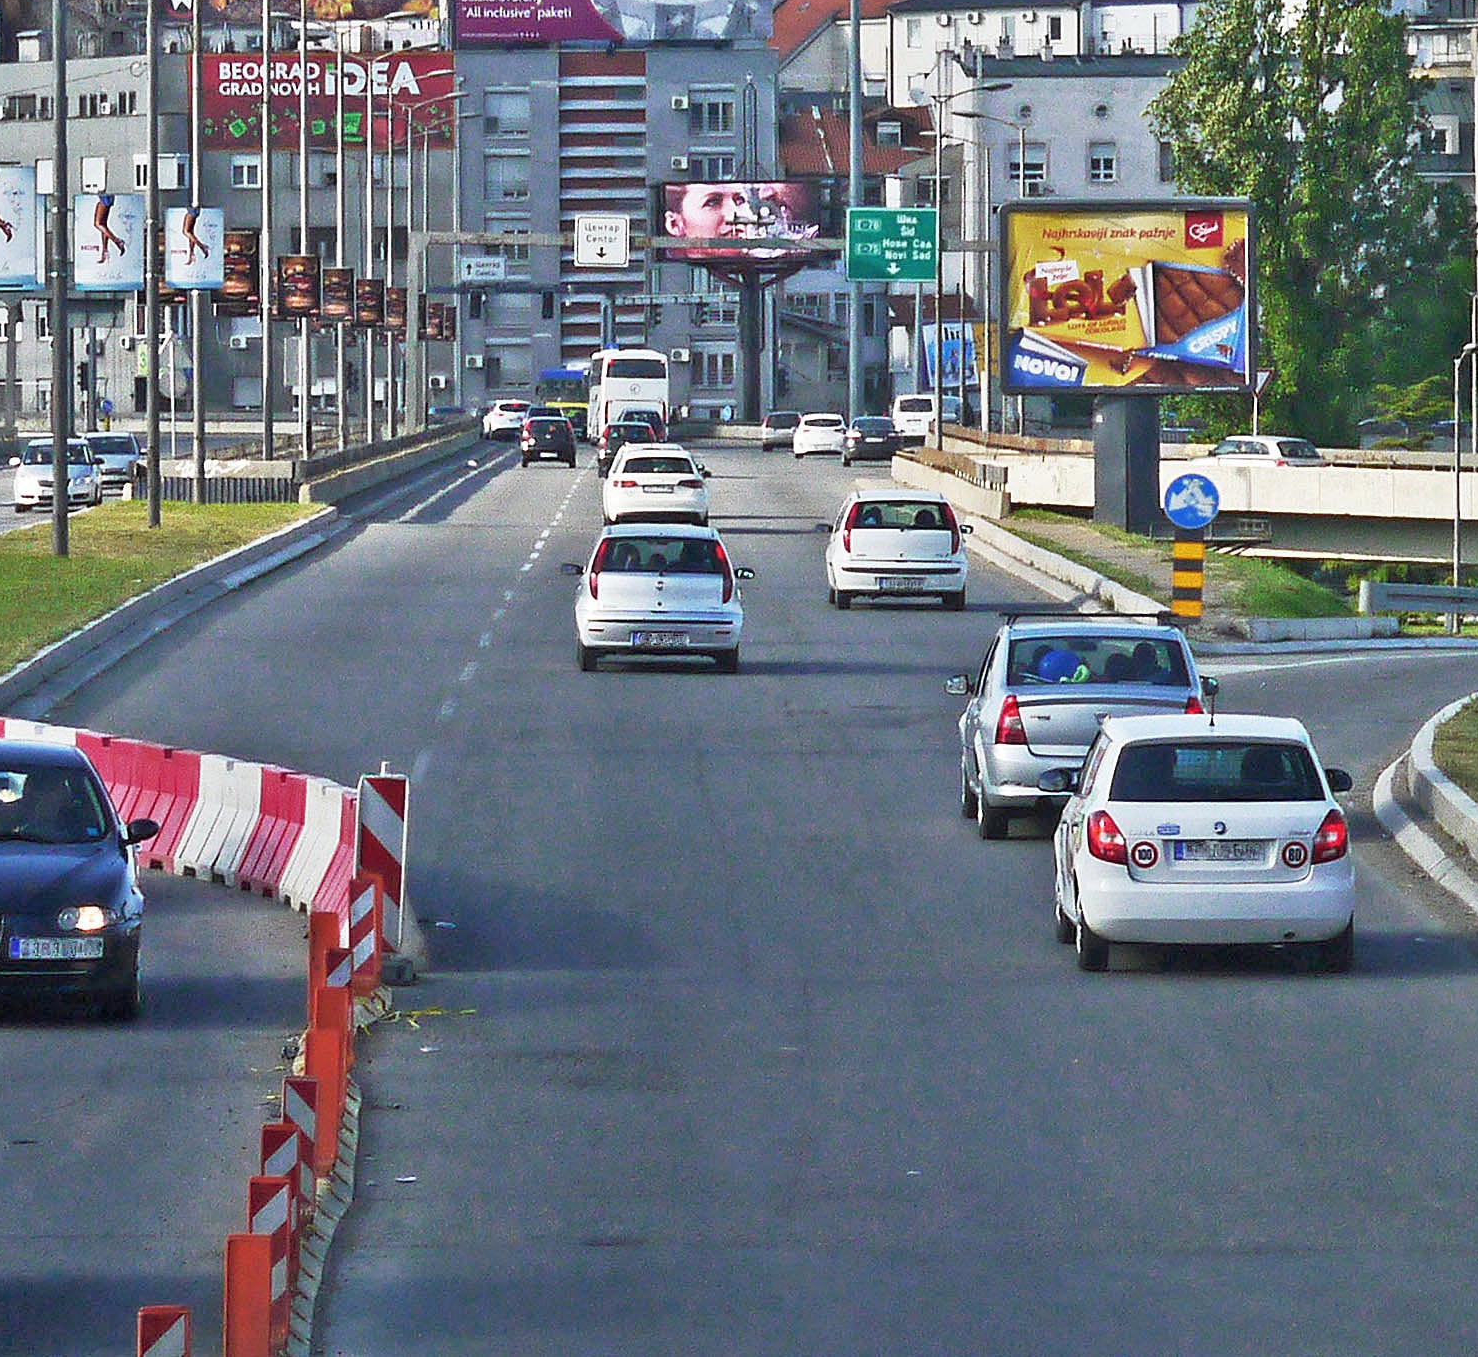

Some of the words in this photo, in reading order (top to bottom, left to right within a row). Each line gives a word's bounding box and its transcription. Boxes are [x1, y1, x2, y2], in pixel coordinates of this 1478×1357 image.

[538, 7, 572, 21] paketi
[219, 62, 321, 80] BEOGRAD
[219, 83, 262, 96] GRAD
[270, 83, 320, 96] NOVH
[1109, 227, 1136, 239] znak
[1139, 226, 1176, 240] pažnje
[885, 250, 907, 260] Novi
[912, 250, 932, 260] Sad
[1013, 354, 1079, 382] NOVO!
